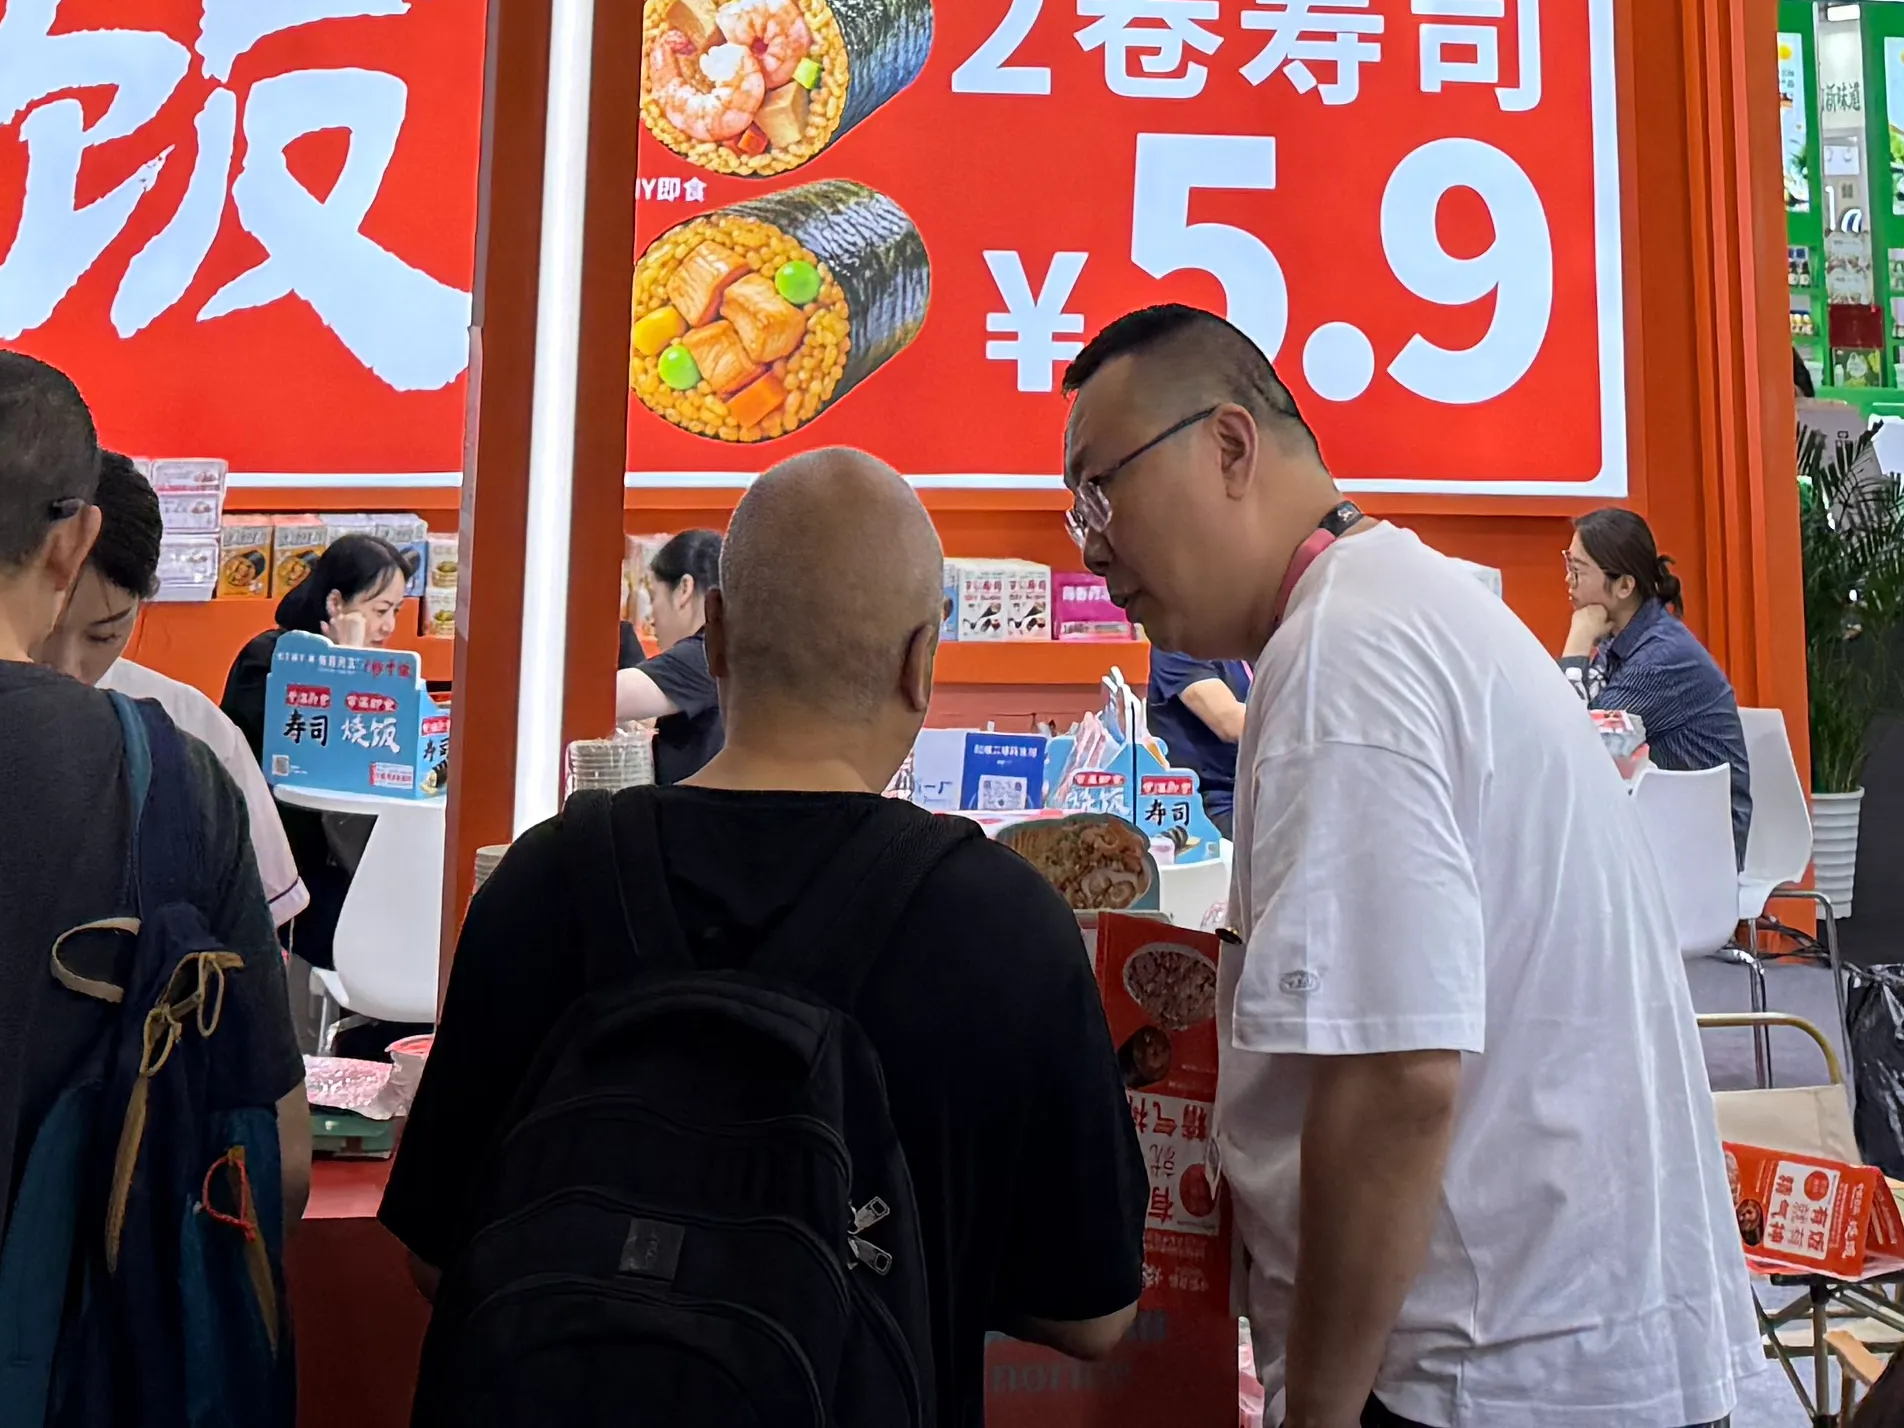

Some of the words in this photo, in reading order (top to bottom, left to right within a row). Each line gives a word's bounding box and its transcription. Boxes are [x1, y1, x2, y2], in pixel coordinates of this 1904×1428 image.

[283, 708, 330, 747] 寿司
[341, 714, 401, 753] 烧饭
[1144, 798, 1190, 826] 寿司
